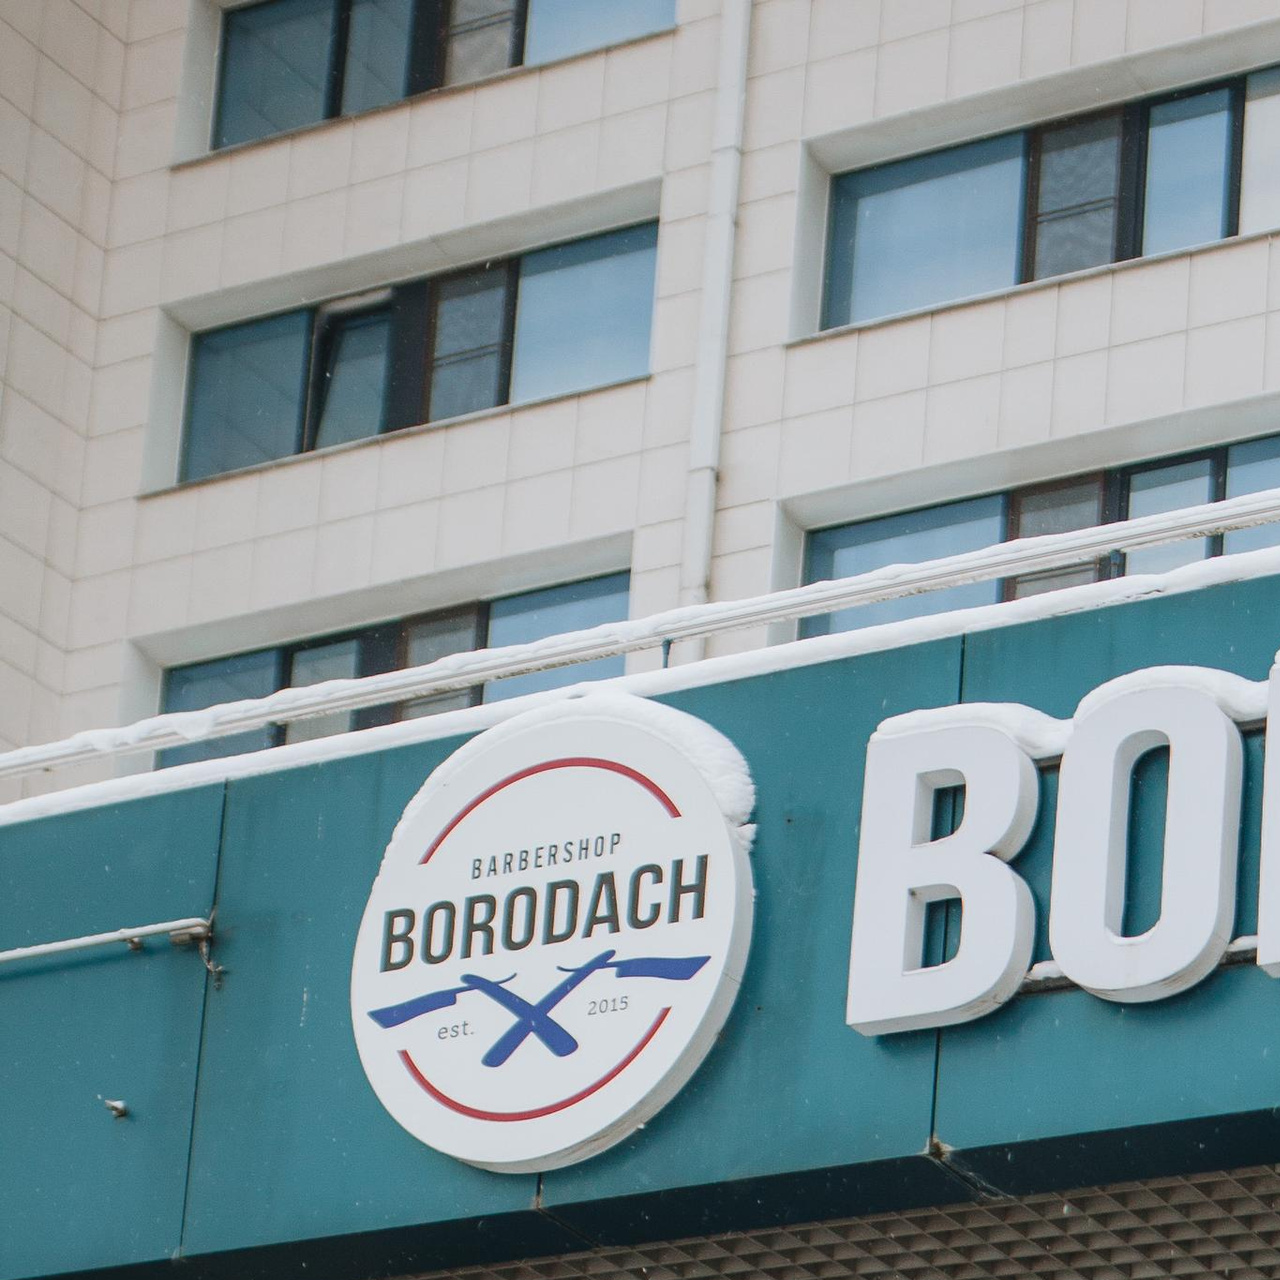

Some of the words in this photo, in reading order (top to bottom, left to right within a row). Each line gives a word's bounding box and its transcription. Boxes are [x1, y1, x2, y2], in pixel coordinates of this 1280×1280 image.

[471, 832, 623, 880] BARBERSHOP
[379, 853, 710, 974] BORODACH
[437, 1019, 476, 1041] est.
[587, 995, 630, 1017] 2015
